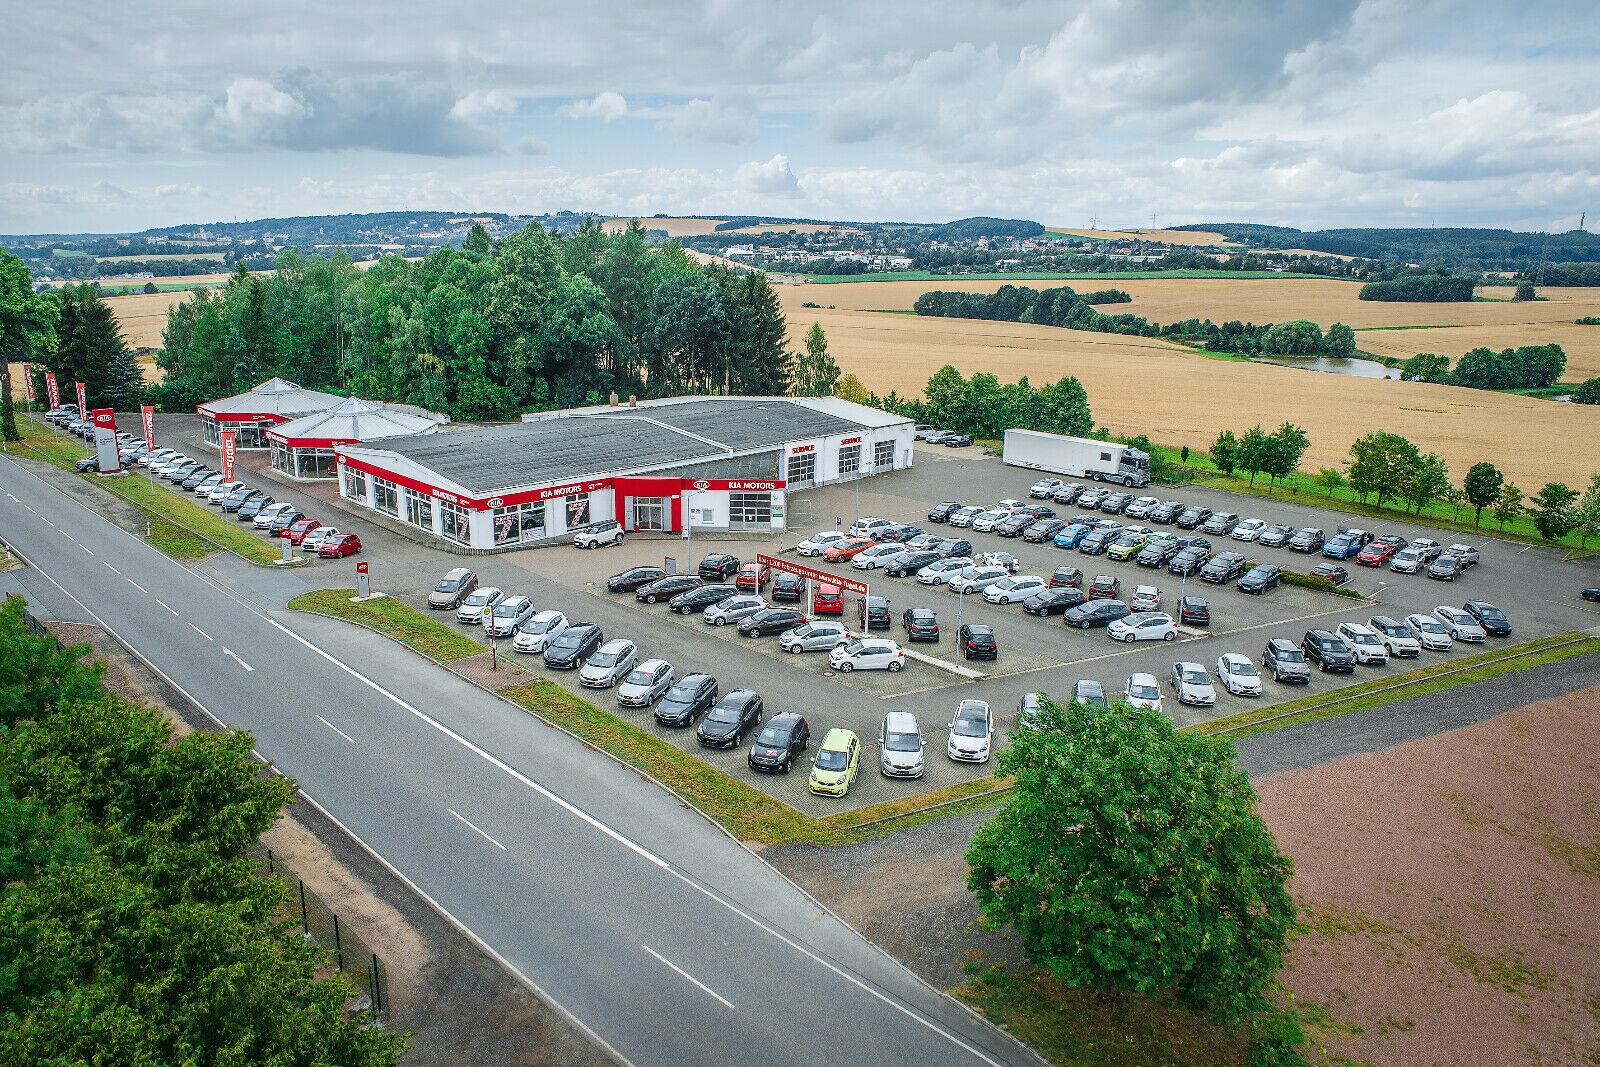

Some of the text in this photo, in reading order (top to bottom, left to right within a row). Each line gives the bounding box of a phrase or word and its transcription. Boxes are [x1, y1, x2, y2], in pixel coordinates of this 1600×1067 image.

[840, 437, 862, 445] SERVICE
[792, 445, 815, 454] SERVICE
[728, 481, 776, 490] KIA MOTORS
[540, 490, 553, 499] KIA
[553, 485, 582, 496] MOTORS
